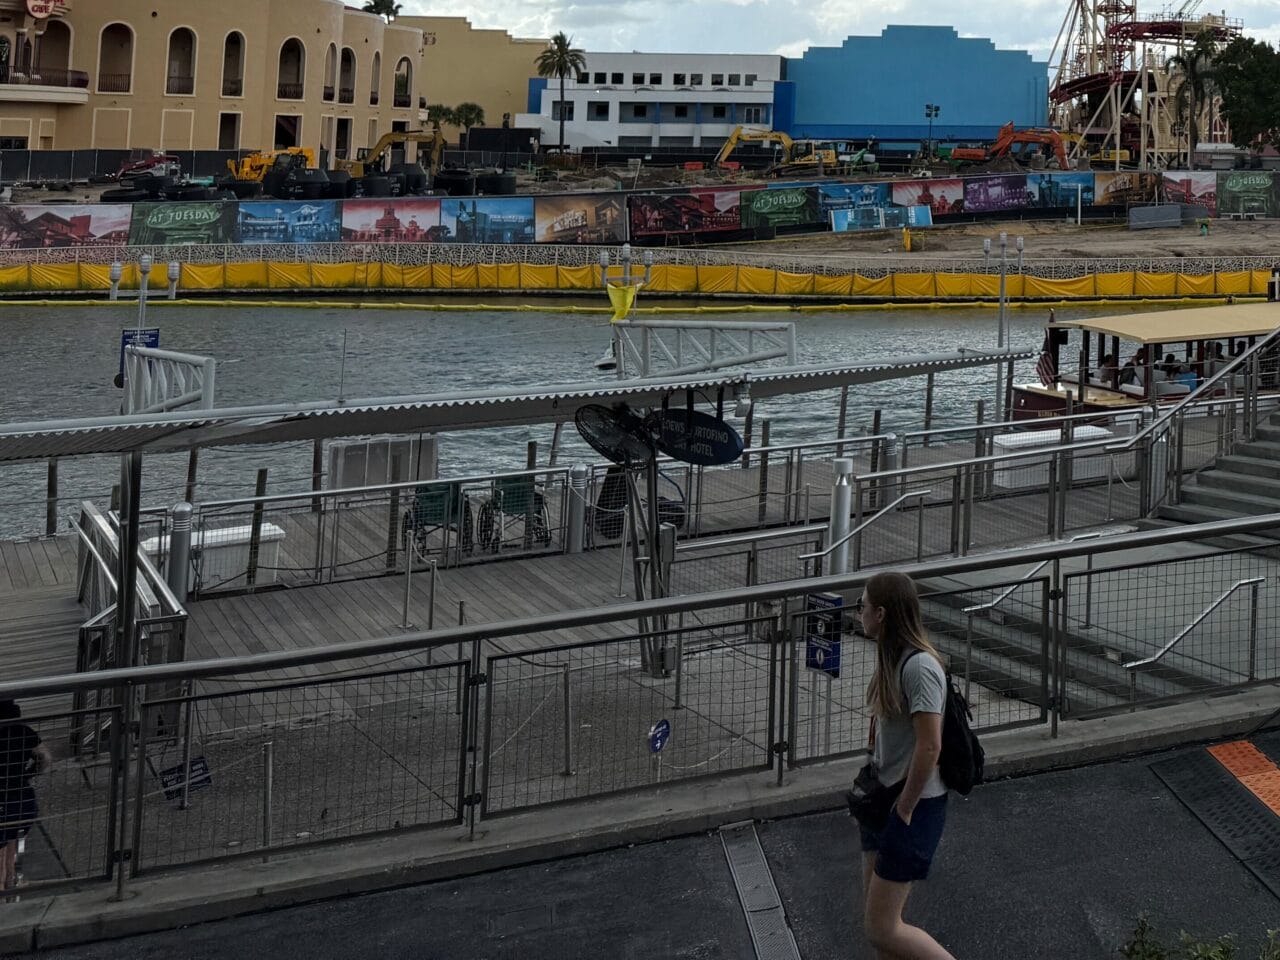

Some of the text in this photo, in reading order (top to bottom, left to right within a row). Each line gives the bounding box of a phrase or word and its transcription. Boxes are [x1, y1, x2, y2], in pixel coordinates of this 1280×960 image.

[768, 194, 802, 207] TUESDAY
[169, 209, 215, 222] TUESDAY
[690, 442, 714, 456] HOTEL
